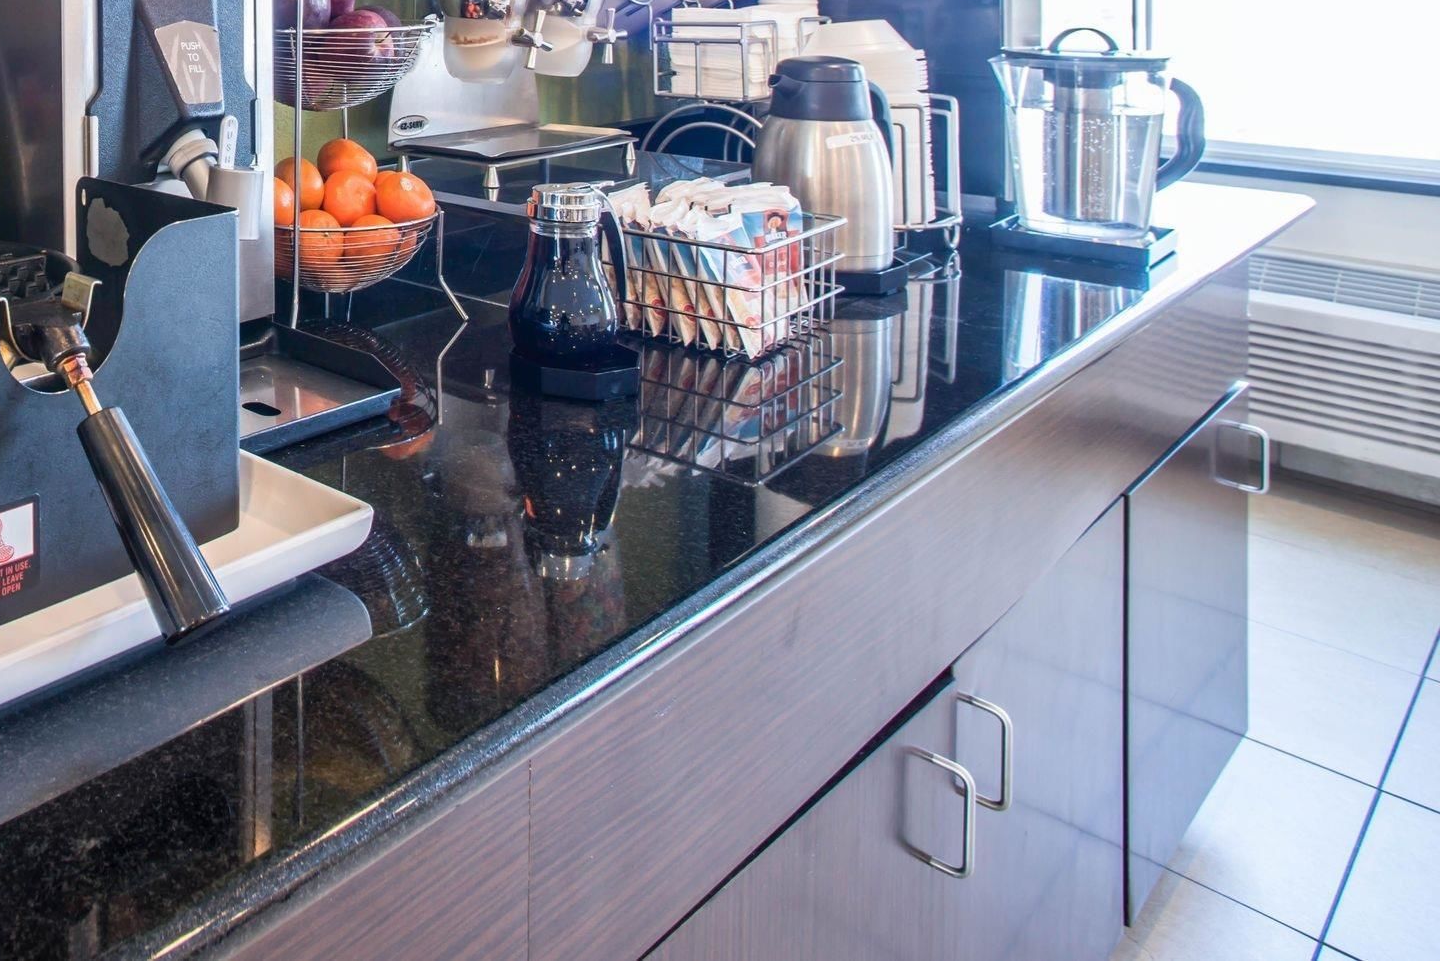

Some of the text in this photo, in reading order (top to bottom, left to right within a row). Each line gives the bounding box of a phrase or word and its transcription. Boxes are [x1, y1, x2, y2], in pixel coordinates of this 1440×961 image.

[181, 41, 202, 51] PUSH
[187, 53, 200, 62] TO
[188, 64, 206, 74] FILL
[399, 120, 426, 131] EZ-SERV
[5, 565, 14, 576] IN
[2, 571, 25, 586] LEAVE
[1, 582, 21, 597] OPEN
